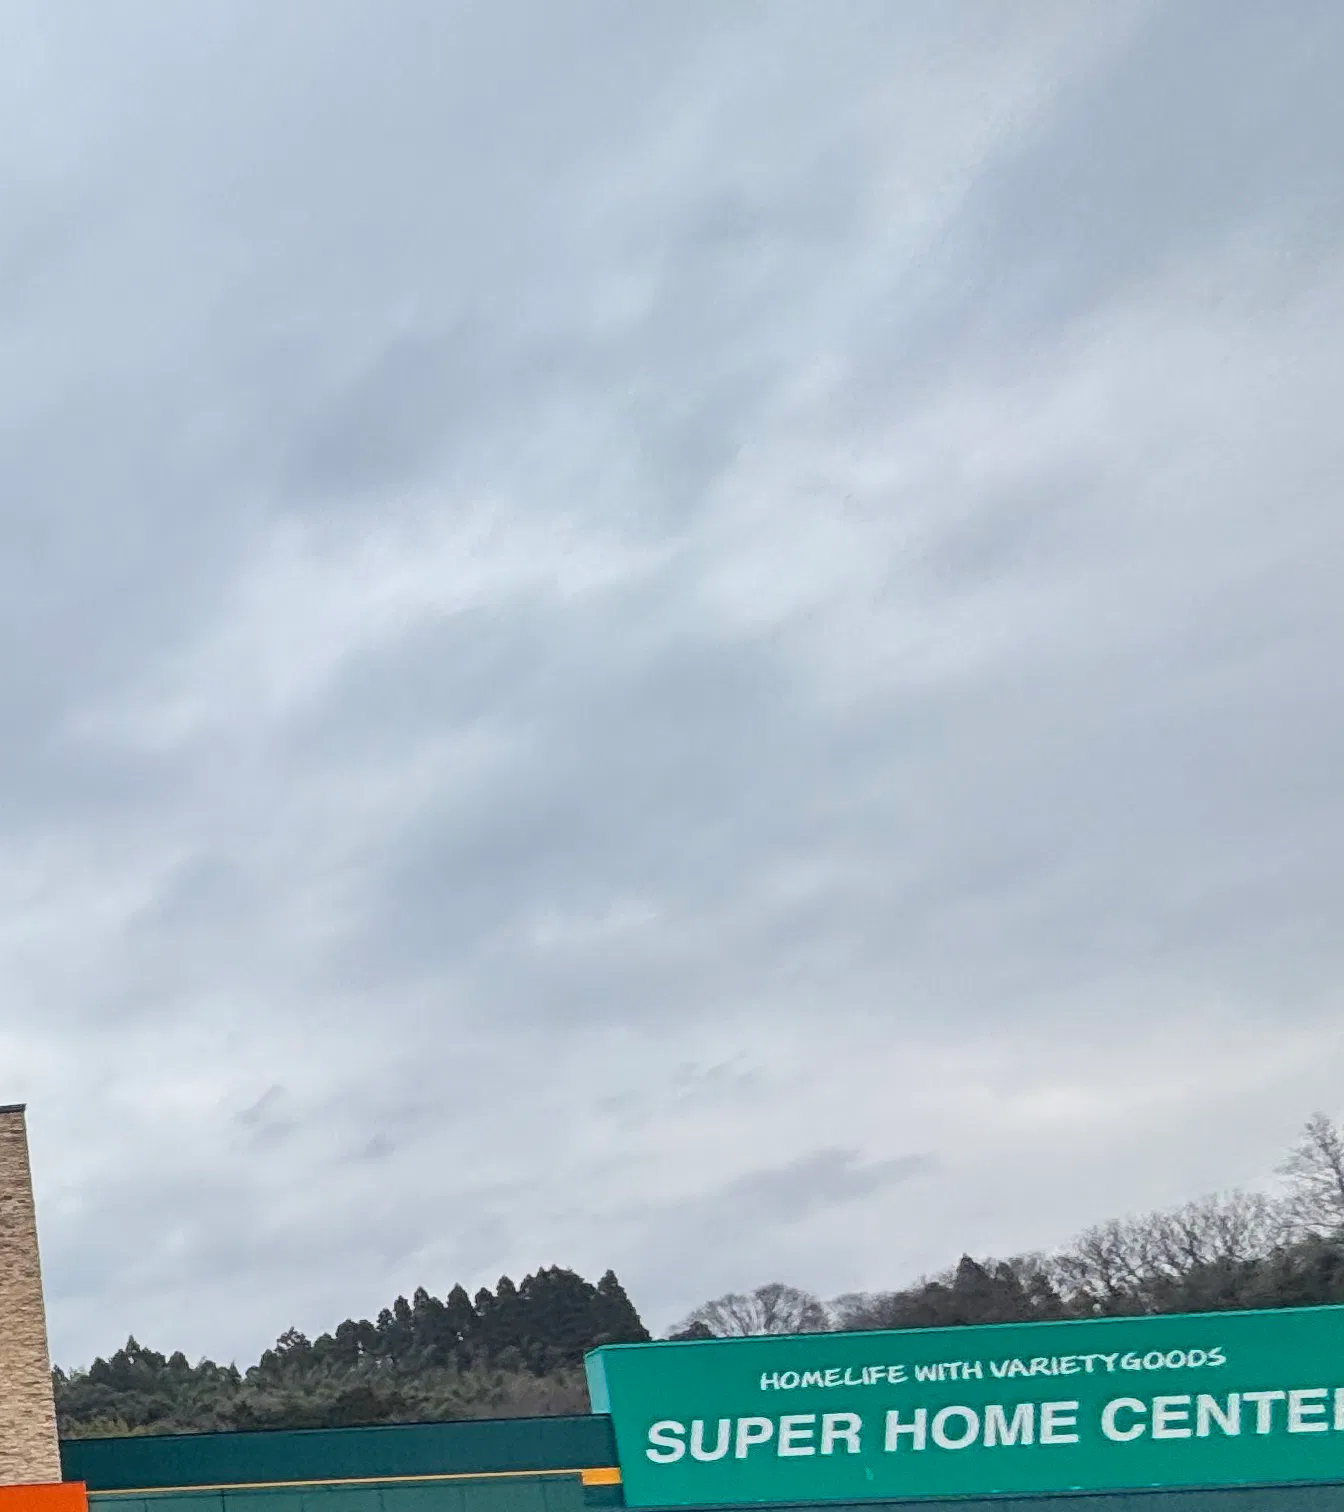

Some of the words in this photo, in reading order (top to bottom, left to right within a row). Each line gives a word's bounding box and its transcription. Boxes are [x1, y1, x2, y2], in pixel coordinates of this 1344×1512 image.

[760, 1365, 908, 1391] HOMELIFE
[915, 1360, 983, 1382] WITH
[646, 1412, 862, 1464] SUPER
[885, 1400, 1080, 1452] HOME
